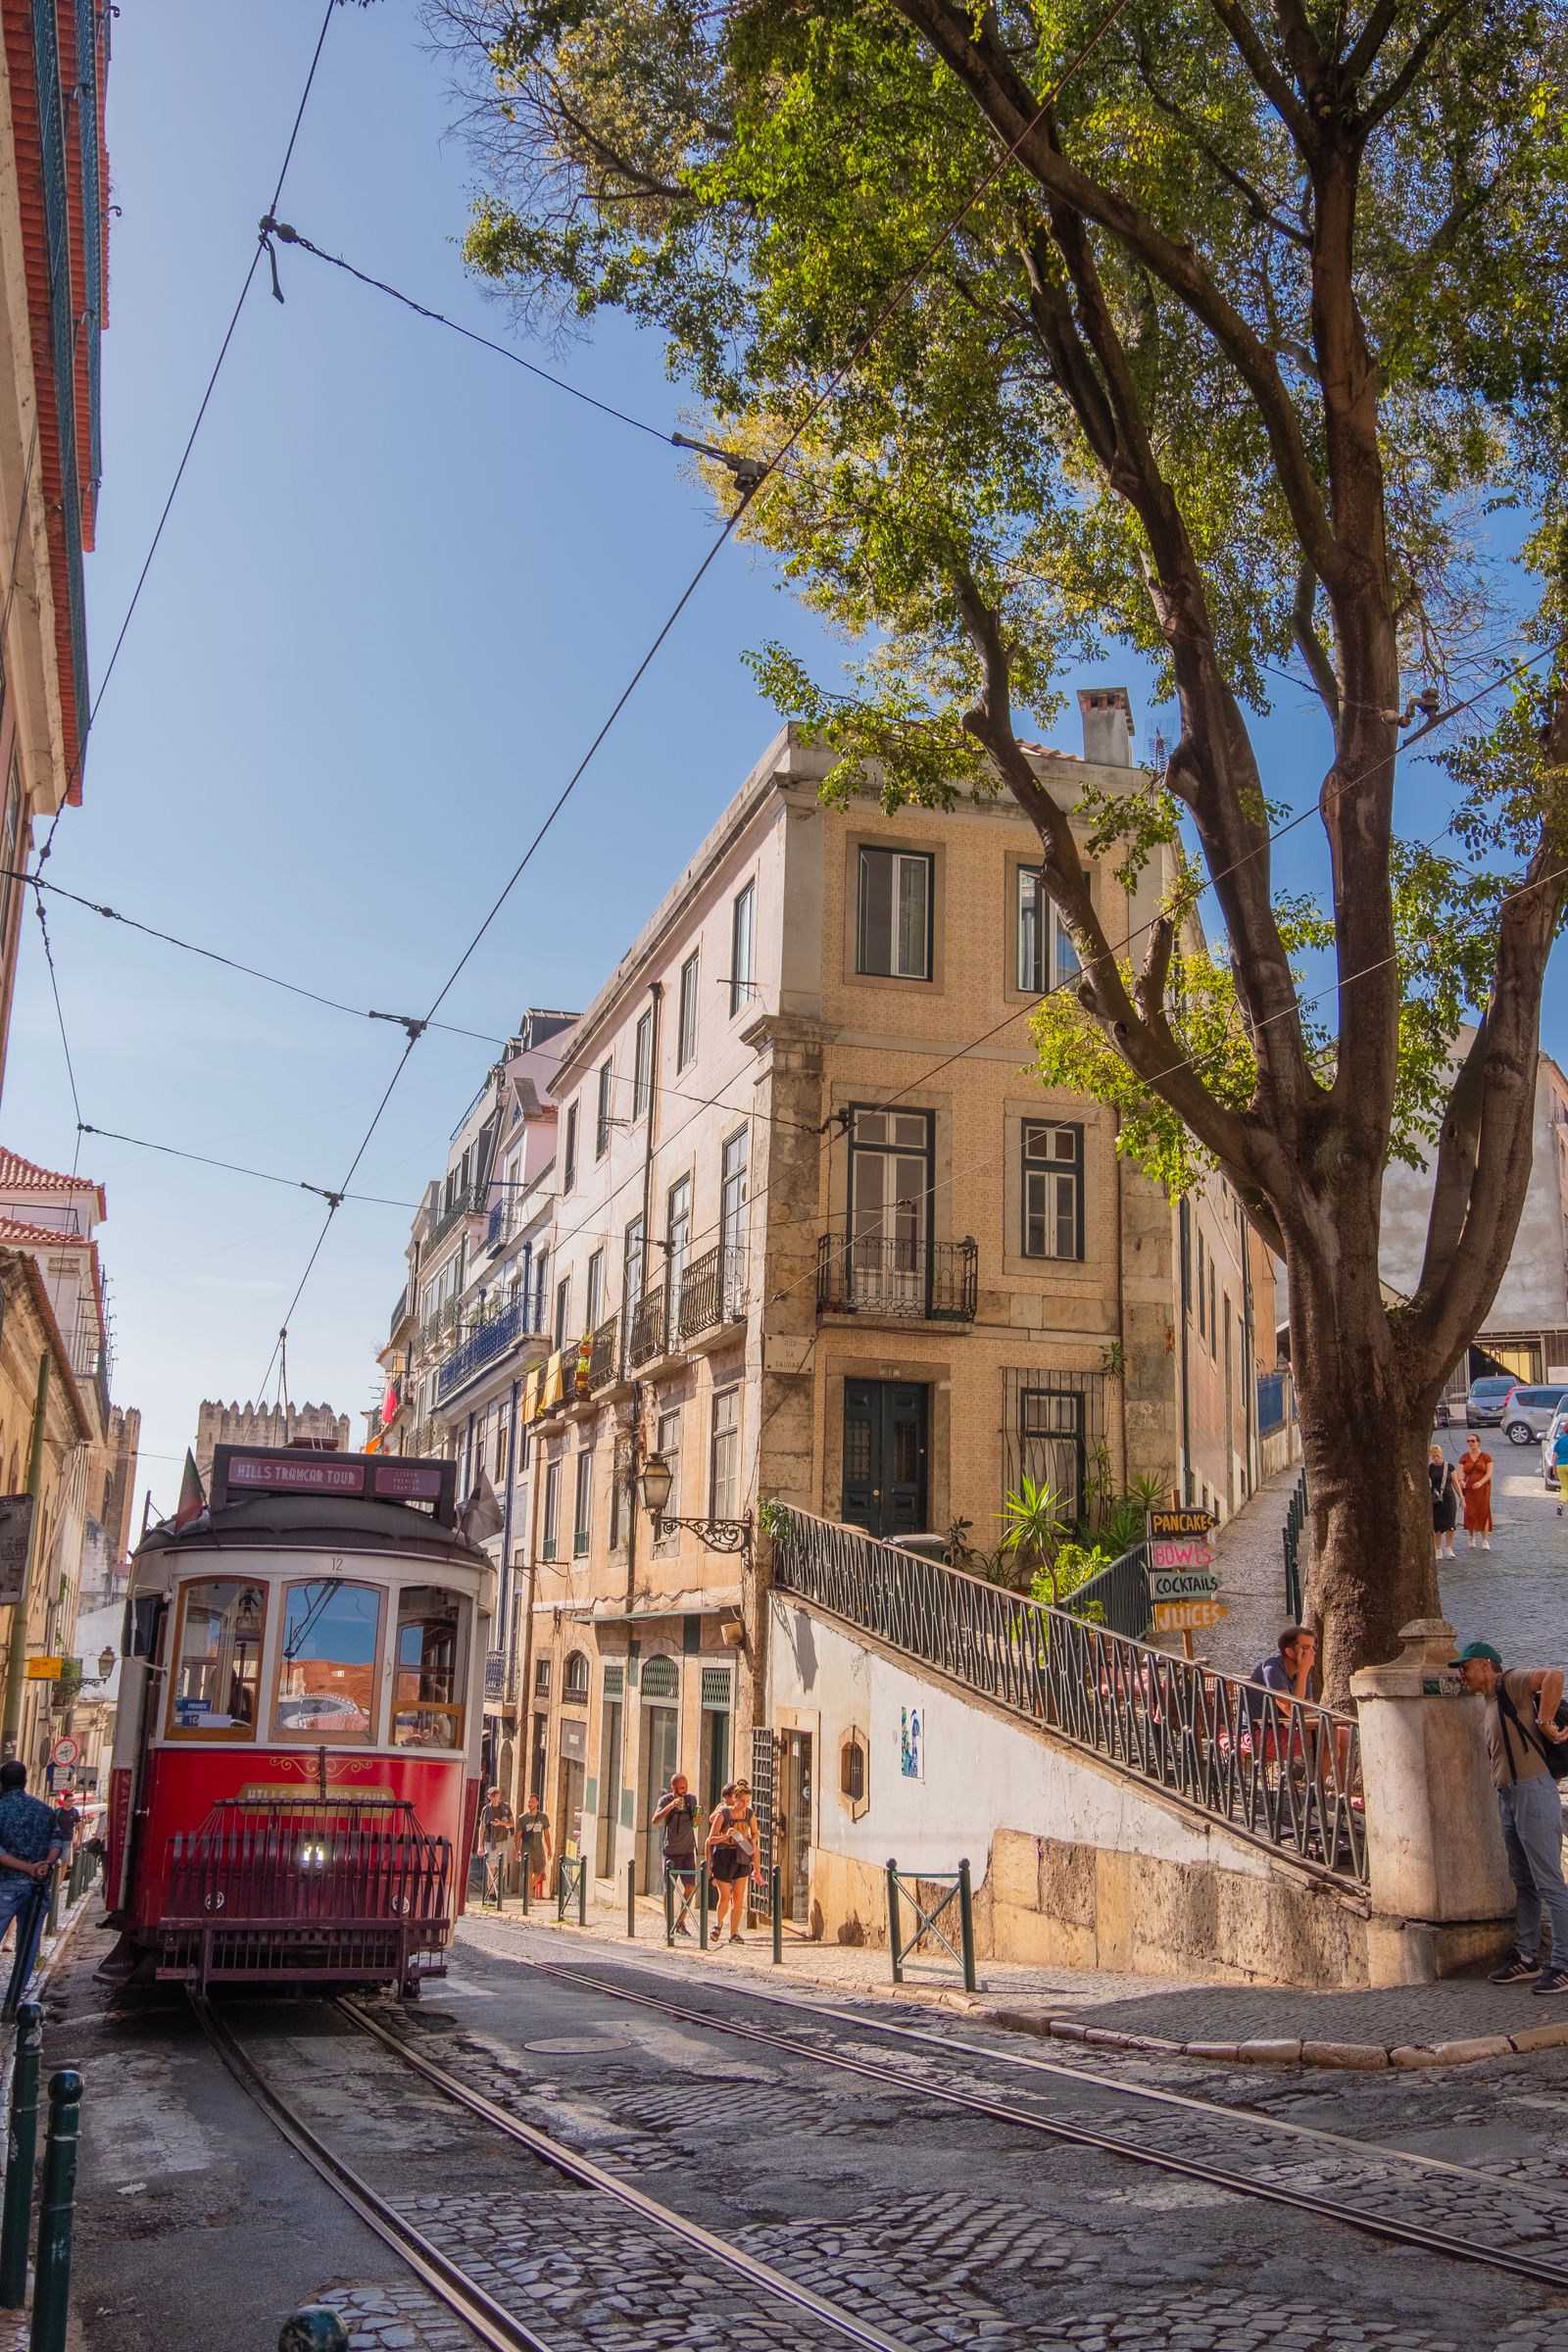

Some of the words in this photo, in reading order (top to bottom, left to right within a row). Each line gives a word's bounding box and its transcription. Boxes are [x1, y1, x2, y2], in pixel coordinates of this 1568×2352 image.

[237, 1464, 272, 1480] HILLS
[275, 1466, 323, 1483] TRAMCAR
[326, 1470, 356, 1486] TOUR
[1152, 1514, 1215, 1533] PANCAKES
[330, 1557, 343, 1571] 12
[1153, 1542, 1212, 1568] BOWLS
